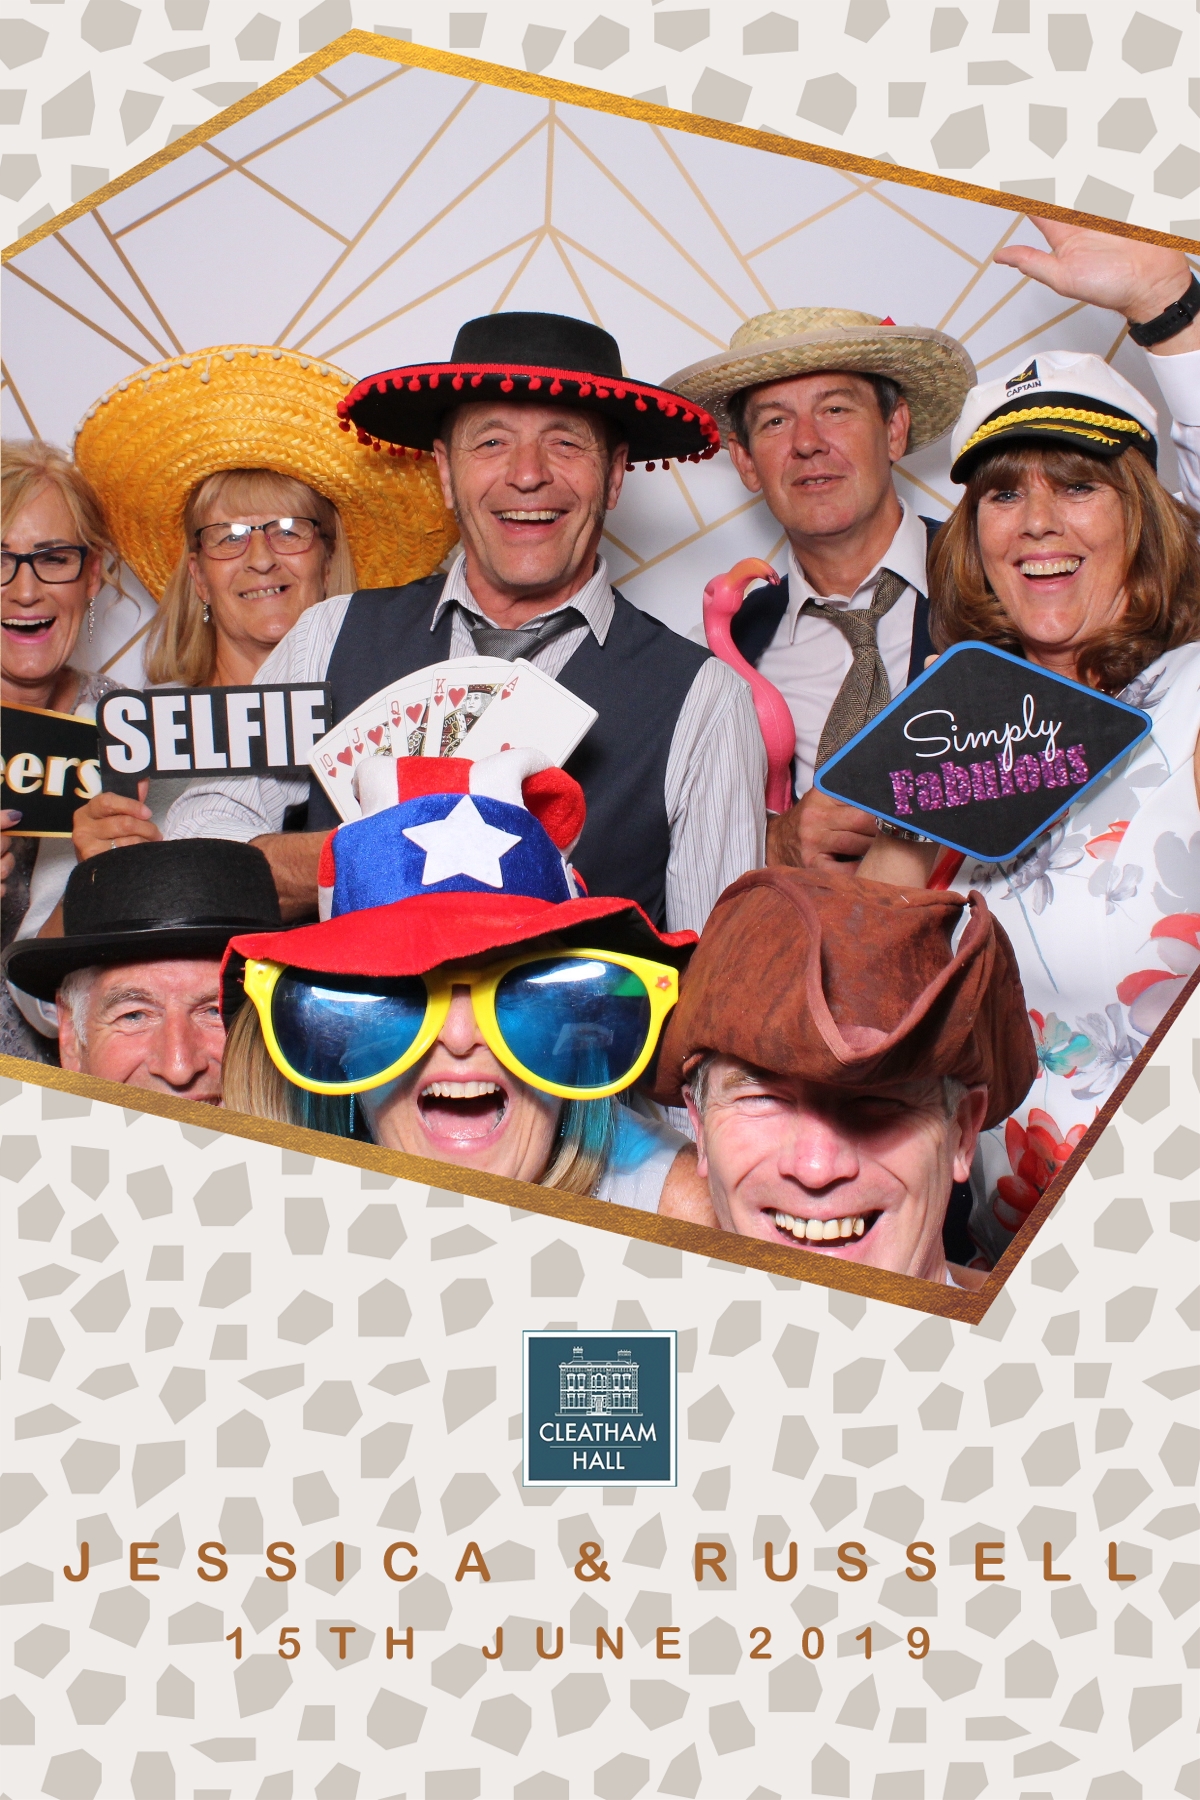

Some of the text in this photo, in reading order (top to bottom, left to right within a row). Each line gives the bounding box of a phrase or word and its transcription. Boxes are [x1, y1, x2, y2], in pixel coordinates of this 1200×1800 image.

[1006, 380, 1042, 398] CAPTAIN
[435, 678, 446, 693] K
[506, 676, 519, 691] A
[390, 700, 400, 715] Q
[103, 690, 326, 774] SELFIE
[352, 727, 360, 744] J
[903, 693, 1062, 772] Simply
[320, 753, 334, 770] 10
[0, 752, 103, 799] ers
[889, 744, 1090, 816] Fabulous
